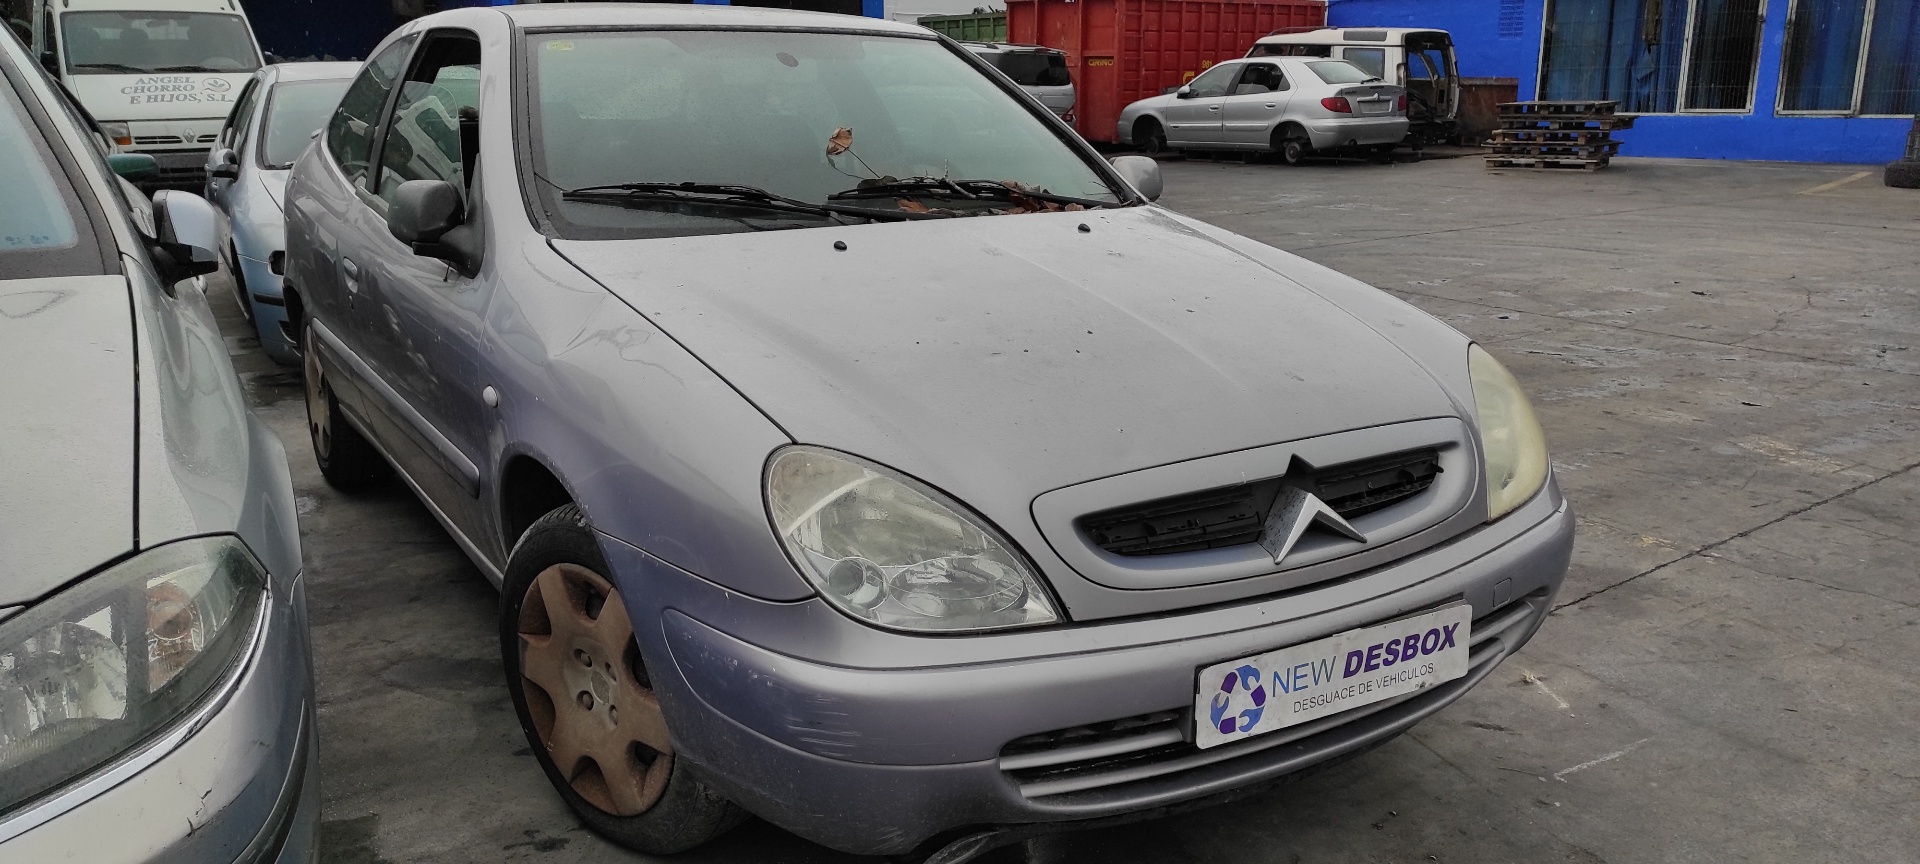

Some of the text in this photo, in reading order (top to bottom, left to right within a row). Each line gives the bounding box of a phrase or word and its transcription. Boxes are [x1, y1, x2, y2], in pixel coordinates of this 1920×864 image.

[135, 76, 195, 85] ANGEL
[120, 84, 195, 95] CHORRO
[130, 95, 141, 105] E
[1273, 622, 1461, 697] NEW DESBOX
[1293, 662, 1435, 713] DESGUACE DE VEHICULOS
